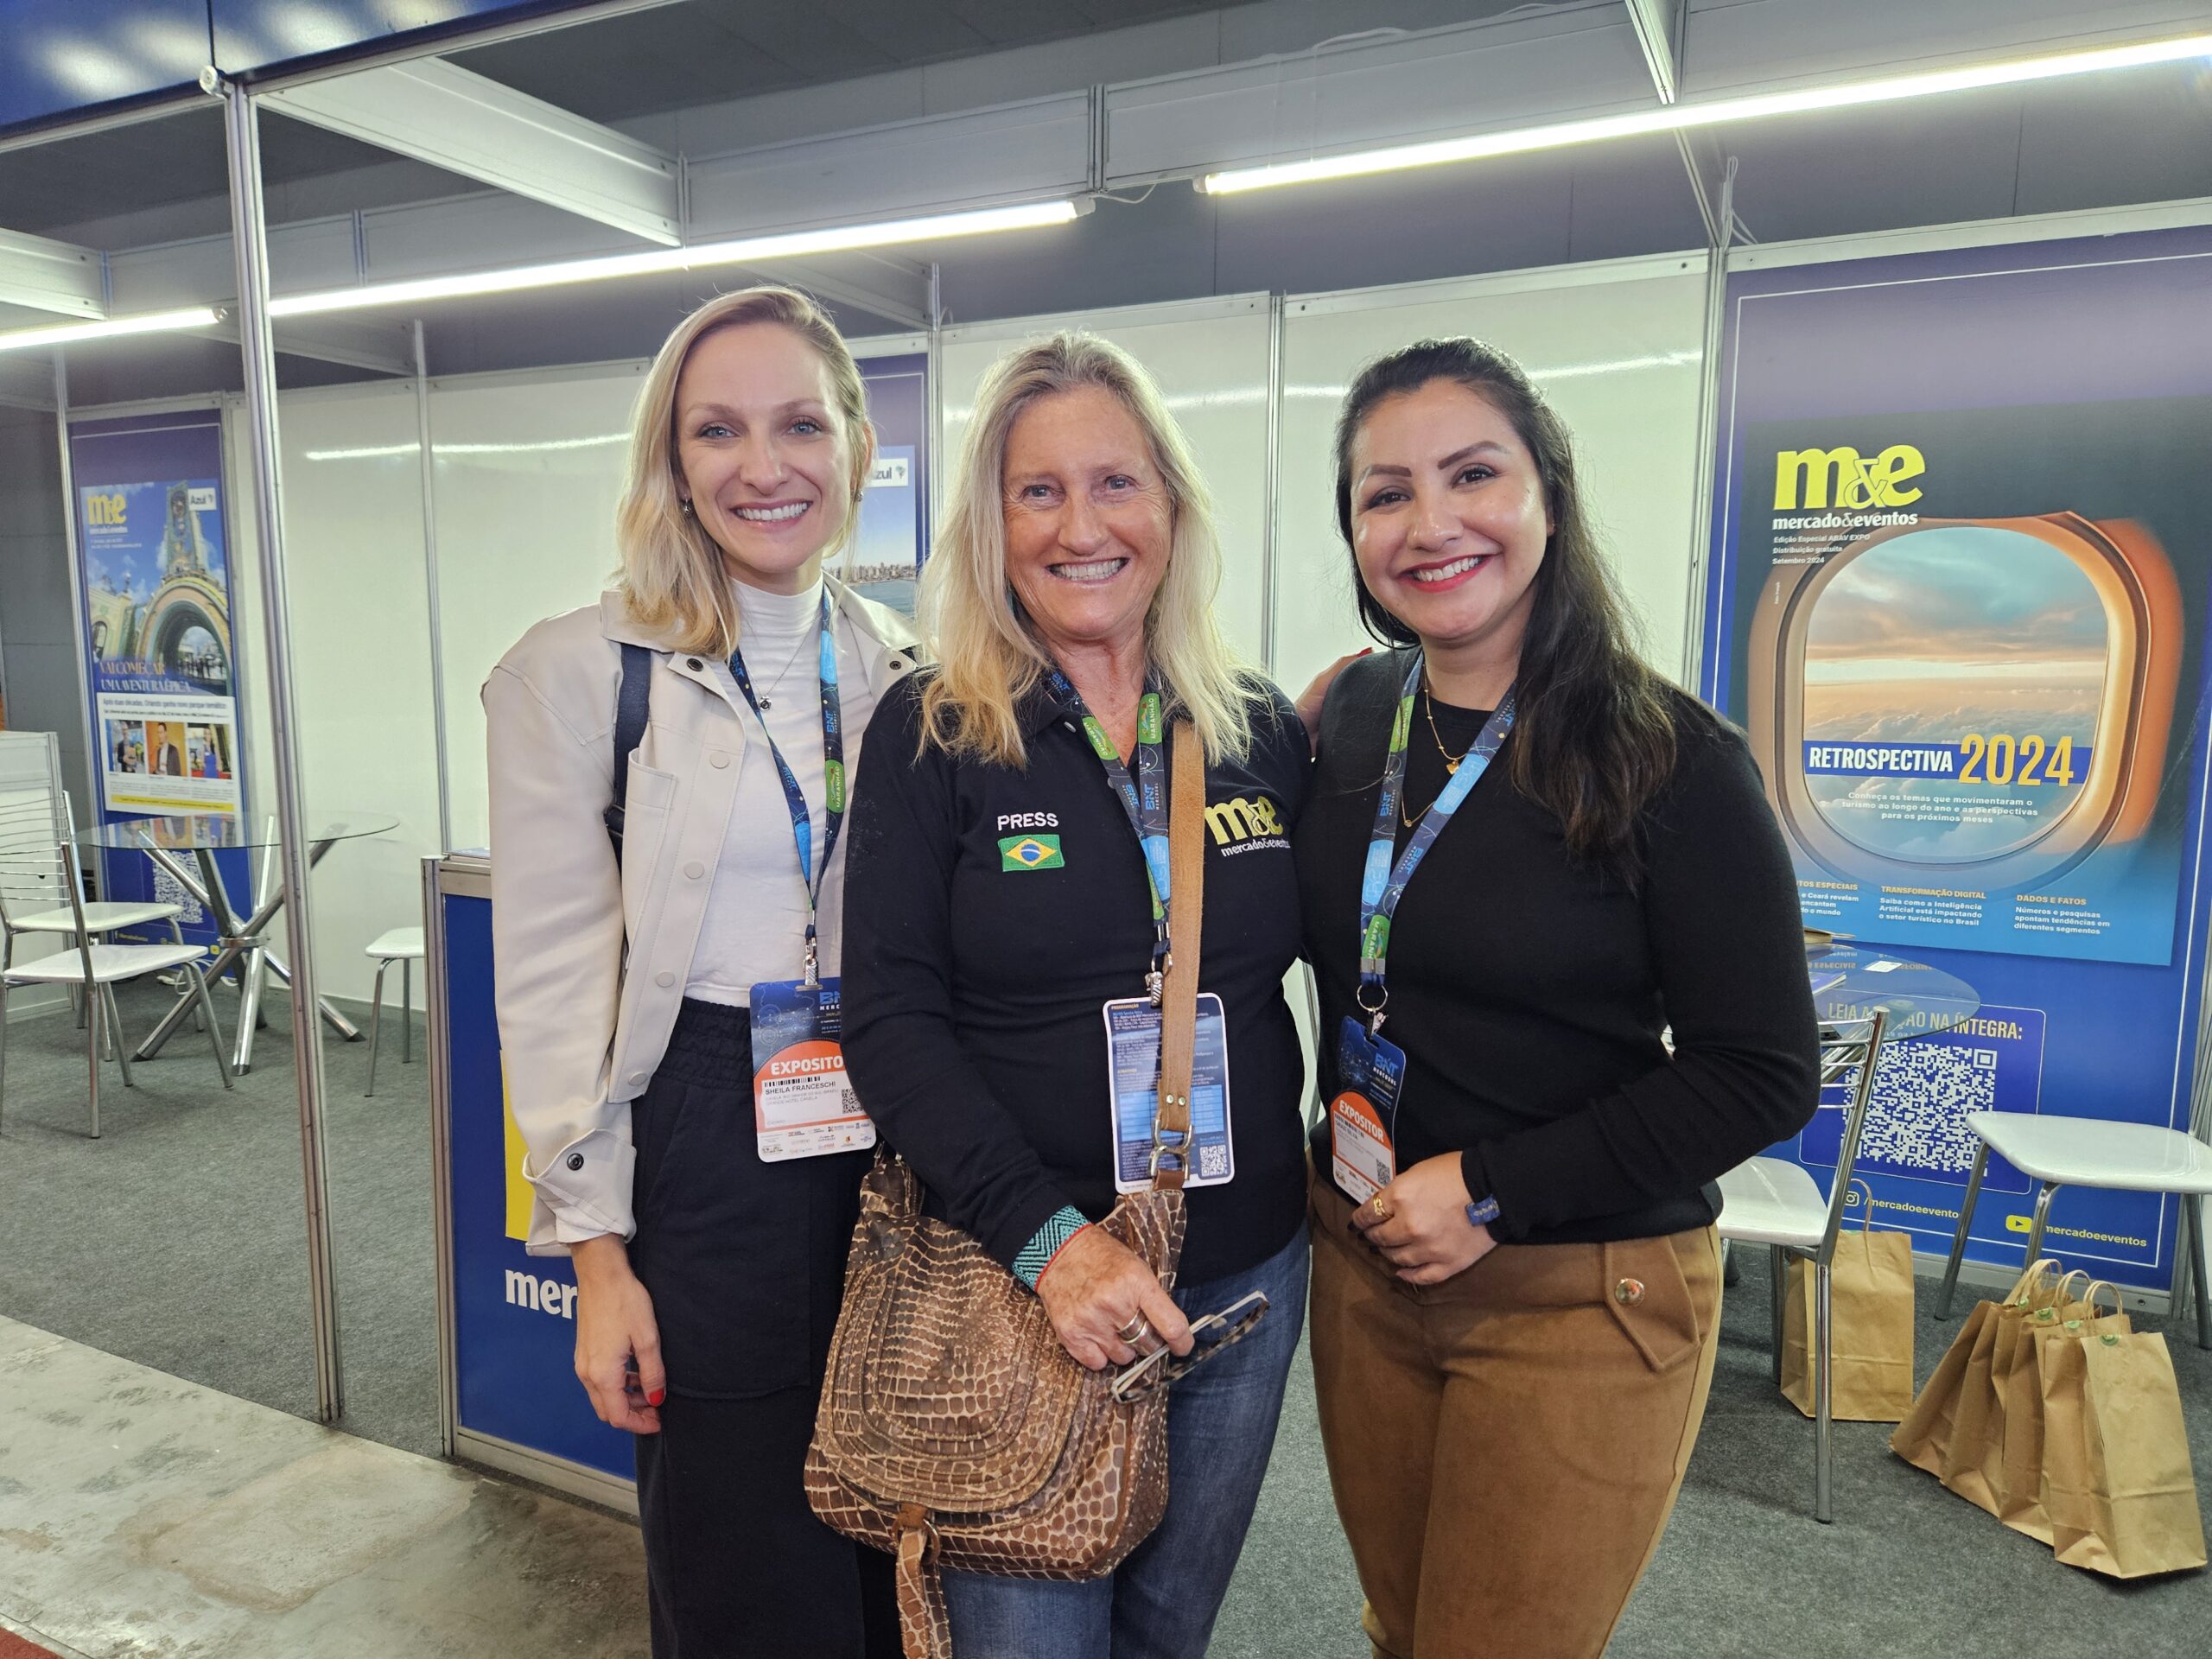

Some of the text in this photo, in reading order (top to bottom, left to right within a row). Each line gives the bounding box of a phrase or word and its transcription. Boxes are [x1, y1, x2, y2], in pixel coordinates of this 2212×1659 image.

[875, 467, 893, 480] zul
[1774, 444, 1925, 511] m&e
[1772, 511, 1918, 531] mercado&eventos
[1774, 533, 1871, 544] Edição Especial ABAV EXPO
[1772, 546, 1843, 555] Distribuição gratuita
[1809, 733, 2075, 787] RETROSPECTIVA 2024
[1144, 783, 1155, 810] BNT
[1848, 791, 1887, 802] Conheça
[1890, 793, 1901, 802] os
[1933, 797, 1951, 805] que
[1953, 796, 2024, 806] movimentaram
[1842, 800, 1877, 809] turismo
[1891, 802, 1918, 813] longo
[1920, 803, 1933, 811] do
[1975, 807, 2038, 817] perspectivas
[997, 812, 1059, 831] PRESS
[1917, 812, 1961, 822] próximos
[1816, 881, 1859, 891] ESPECIAIS
[1880, 886, 1986, 899] TRANSFORMAÇÃO DIGITAL
[1808, 892, 1829, 900] Ceará
[1830, 893, 1859, 902] revelam
[2016, 894, 2049, 904] DADOS
[2057, 897, 2087, 906] FATOS
[1879, 905, 1983, 919] Artificial está impactando
[1934, 900, 1982, 911] Inteligência
[2015, 906, 2051, 915] Números
[2060, 910, 2101, 918] pesquisas
[1907, 913, 1942, 924] turístico
[2051, 917, 2096, 926] tendências
[2014, 923, 2101, 935] diferentes segmentos
[1827, 1002, 1857, 1020] LEIA
[1929, 1012, 1950, 1030] NA
[1955, 1012, 2023, 1040] ÍNTEGRA:
[771, 1056, 844, 1076] EXPOSITO
[1375, 1053, 1398, 1077] BNT
[766, 1081, 836, 1096] SHEILA FRANCESCHI
[1339, 1100, 1384, 1143] EXPOSITOR
[1864, 1197, 1960, 1219] /mercadoeevento
[2045, 1224, 2147, 1248] mercadoeeventos
[505, 1269, 577, 1319] mer
